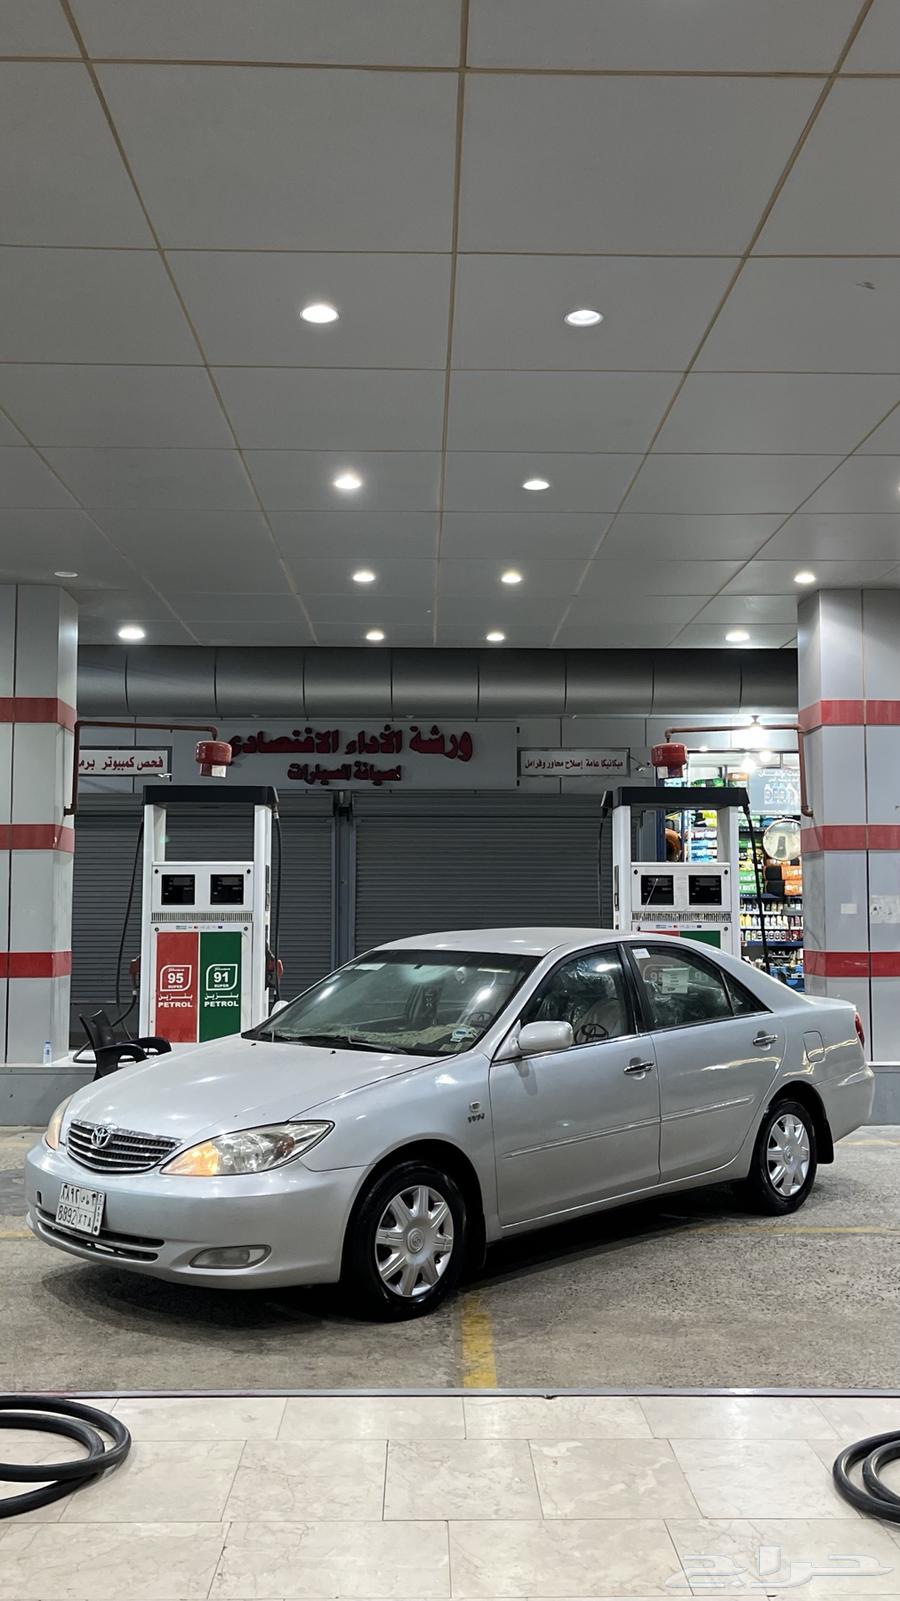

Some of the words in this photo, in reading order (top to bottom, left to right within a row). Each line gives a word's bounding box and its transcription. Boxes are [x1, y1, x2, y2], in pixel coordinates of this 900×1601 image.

[344, 724, 402, 755] الأداء
[409, 725, 473, 762] ورشة
[79, 759, 95, 771] برم
[102, 756, 135, 771] كمبيوتر
[137, 756, 164, 770] فحص
[565, 759, 583, 769] إصلاح
[585, 758, 600, 767] عامة
[601, 758, 623, 769] ميكانيكا
[287, 762, 352, 786] السيارات
[167, 972, 184, 984] 95
[213, 972, 229, 983] 91
[58, 1204, 77, 1225] 8892
